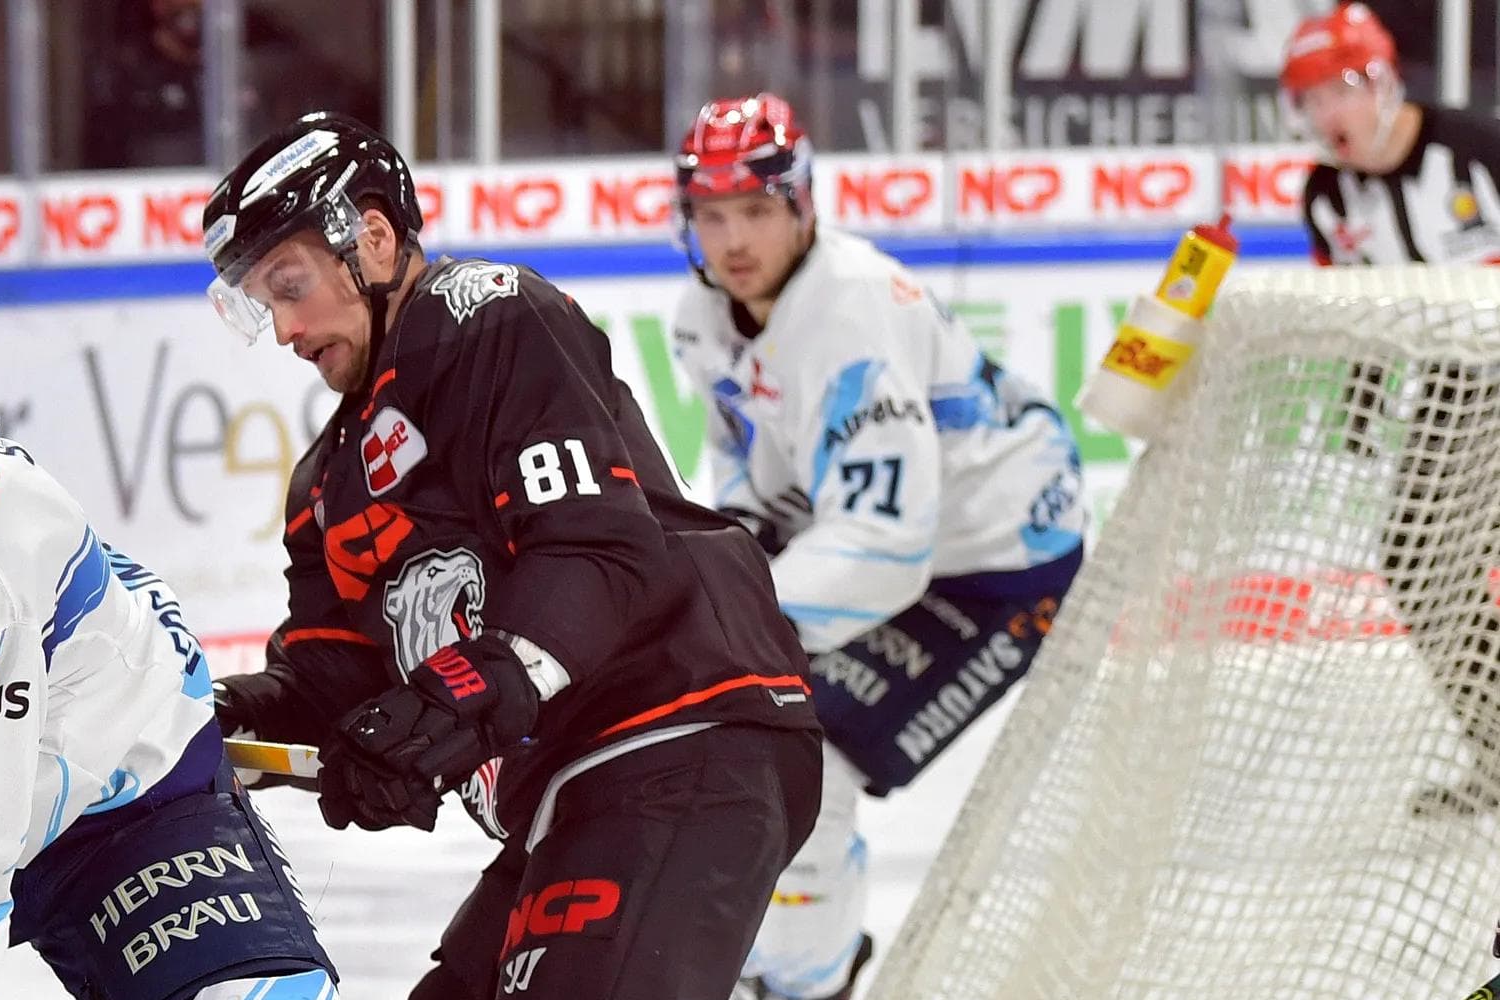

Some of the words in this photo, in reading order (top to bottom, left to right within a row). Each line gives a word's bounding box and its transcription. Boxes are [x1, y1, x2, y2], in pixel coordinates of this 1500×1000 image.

[518, 438, 602, 506] 81
[841, 455, 905, 519] 71
[895, 630, 1023, 765] SATURN
[89, 842, 256, 944] HERRN
[121, 891, 263, 976] BRÄU
